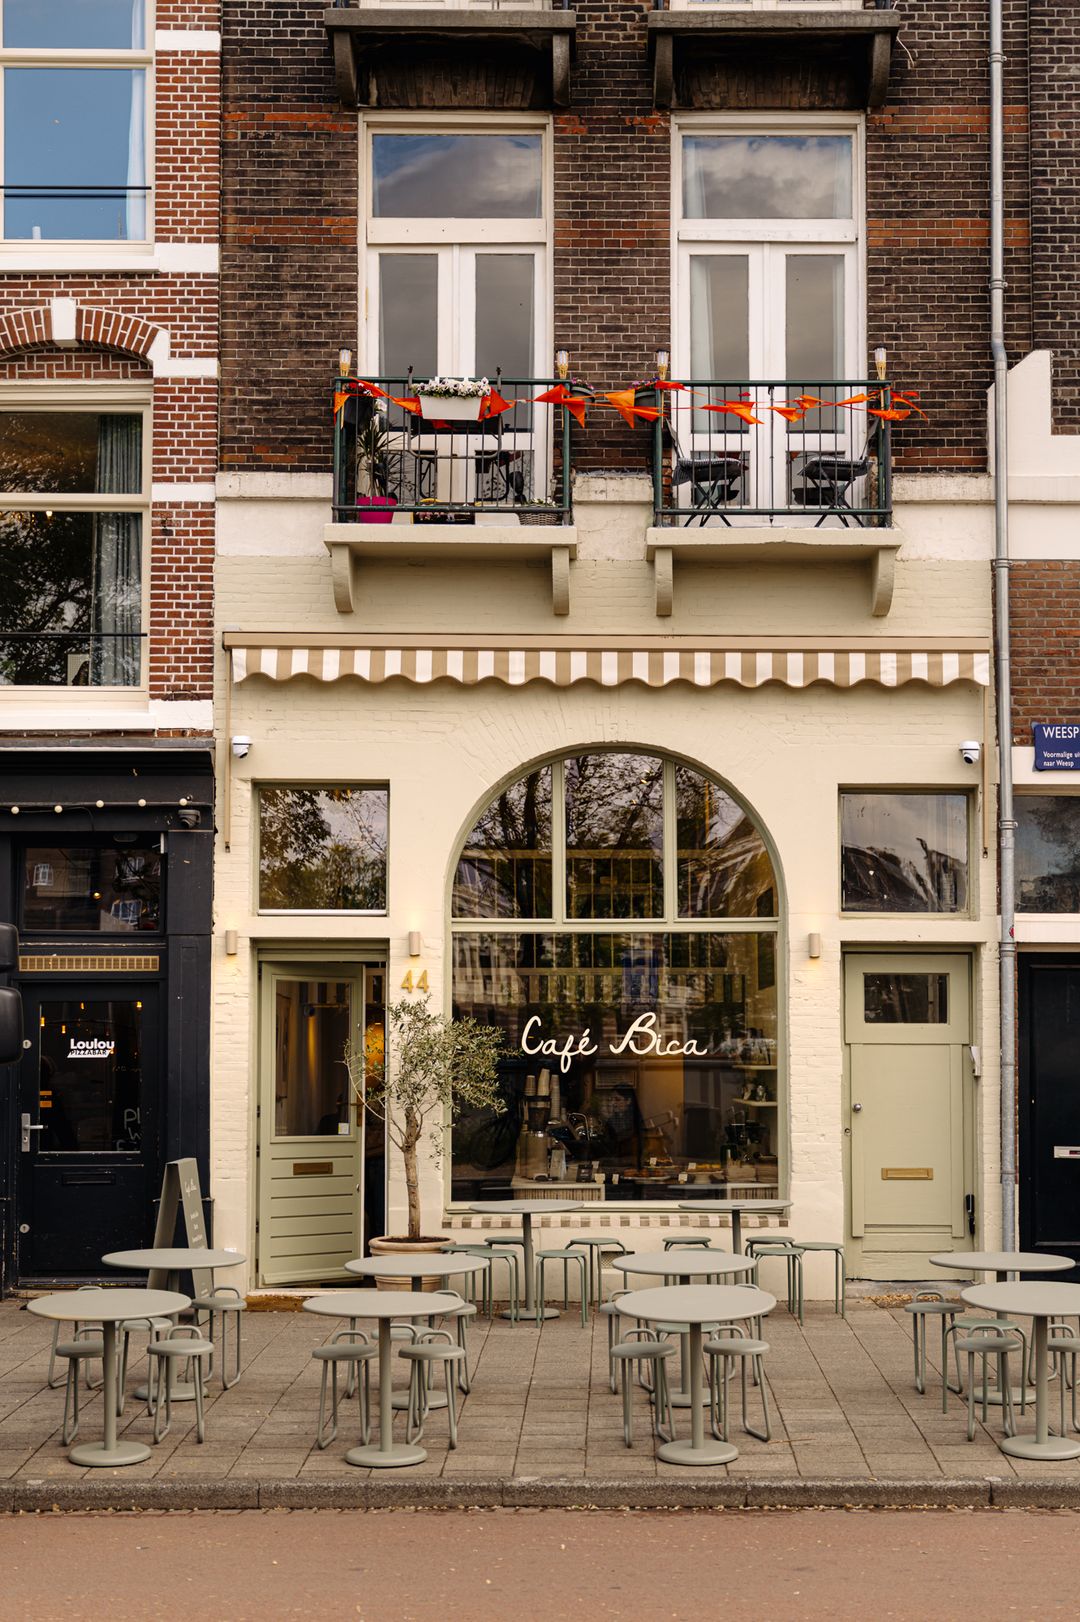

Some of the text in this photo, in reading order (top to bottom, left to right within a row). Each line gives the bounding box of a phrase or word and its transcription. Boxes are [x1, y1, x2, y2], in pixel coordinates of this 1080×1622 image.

[1042, 726, 1080, 739] WEESP
[1043, 751, 1073, 759] Voormalige
[1056, 760, 1075, 768] Weesp
[400, 969, 430, 993] 44
[70, 1038, 115, 1049] Loulou
[521, 1011, 708, 1074] Café Bica
